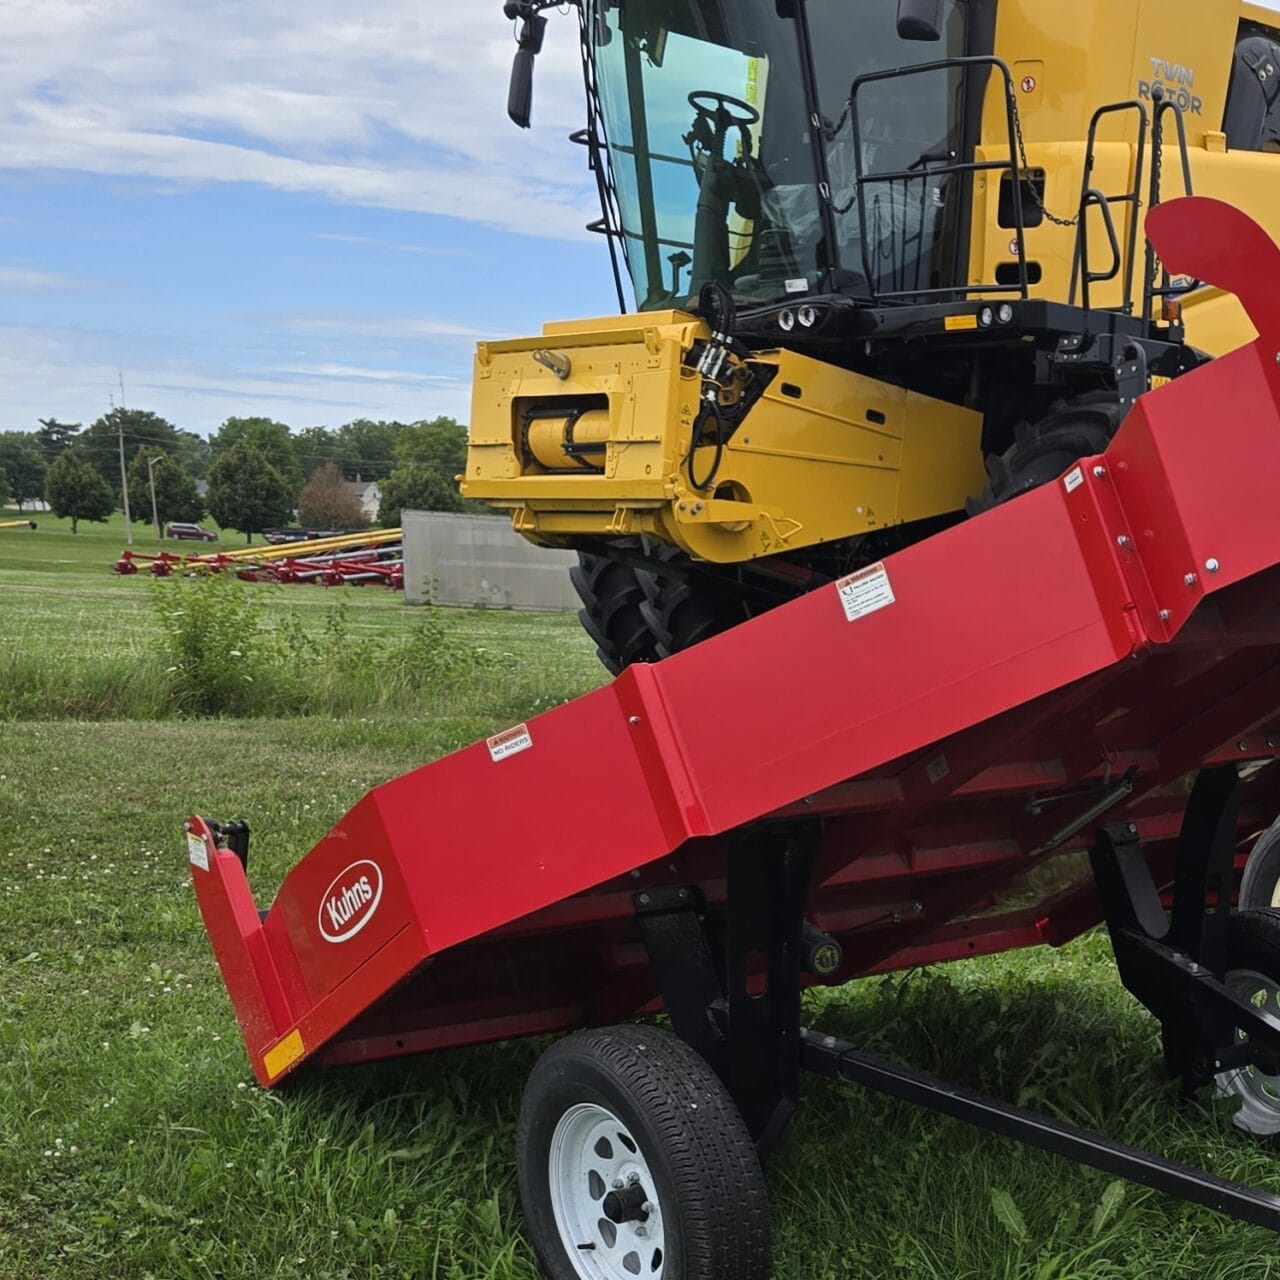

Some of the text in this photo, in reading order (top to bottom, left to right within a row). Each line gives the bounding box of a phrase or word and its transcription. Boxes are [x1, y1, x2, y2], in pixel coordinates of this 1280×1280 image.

[1150, 56, 1194, 88] TWIN
[1138, 79, 1203, 117] ROTOR
[326, 875, 373, 931] Kuhns
